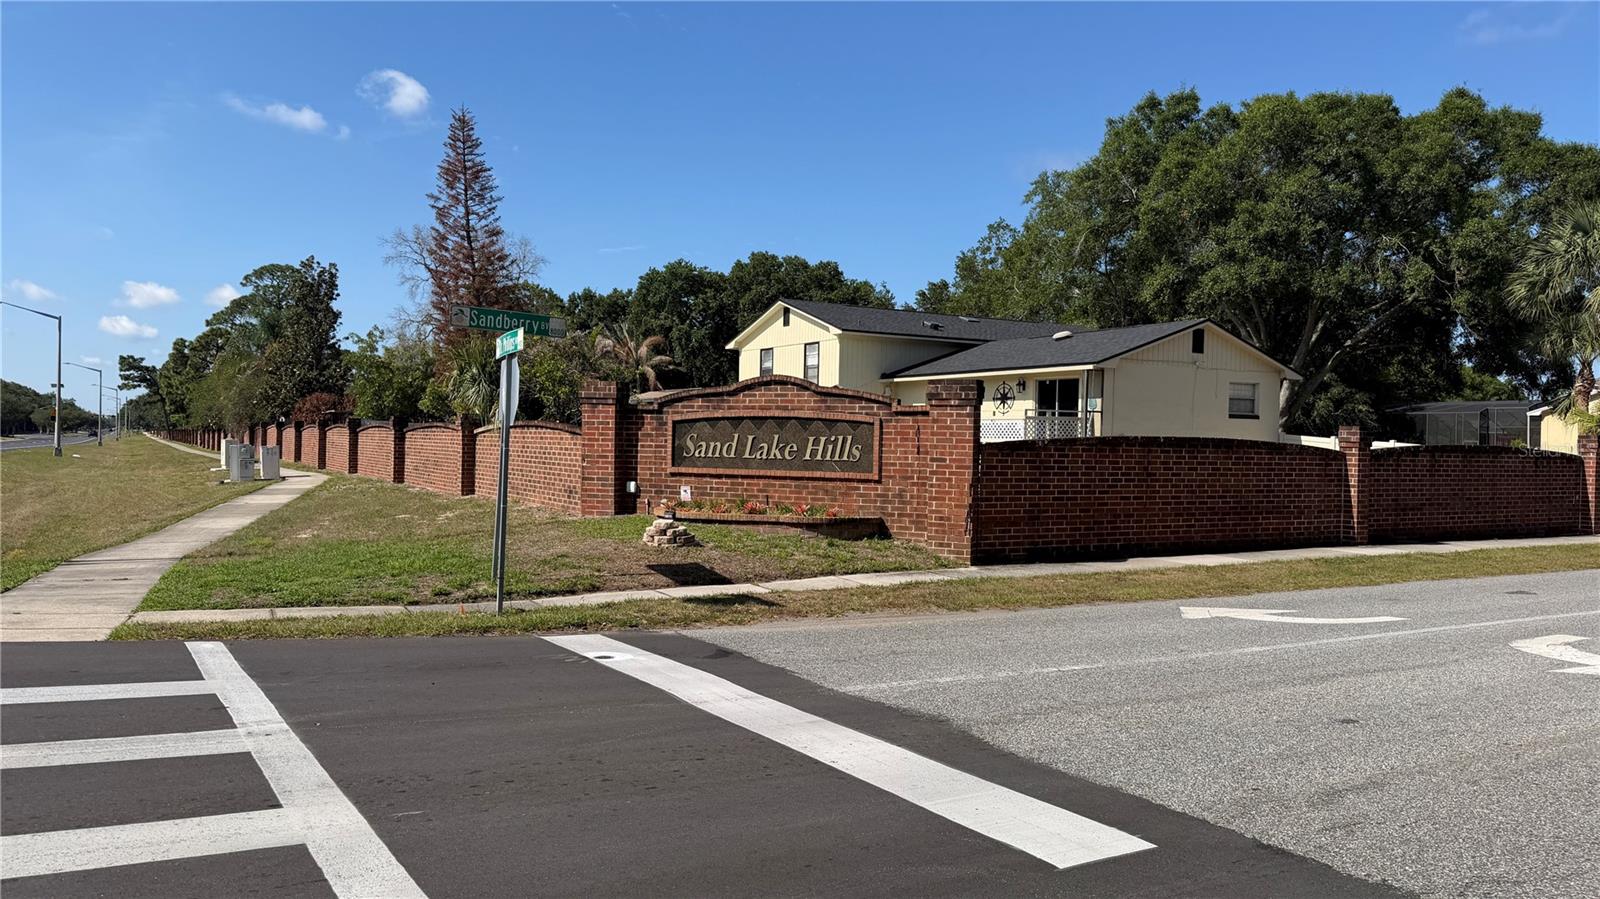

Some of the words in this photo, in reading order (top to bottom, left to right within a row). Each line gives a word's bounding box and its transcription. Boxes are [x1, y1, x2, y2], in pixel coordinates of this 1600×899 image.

[470, 310, 539, 334] Sandberry
[683, 433, 740, 458] Sand
[742, 434, 798, 460] Lake
[803, 435, 863, 462] Hills
